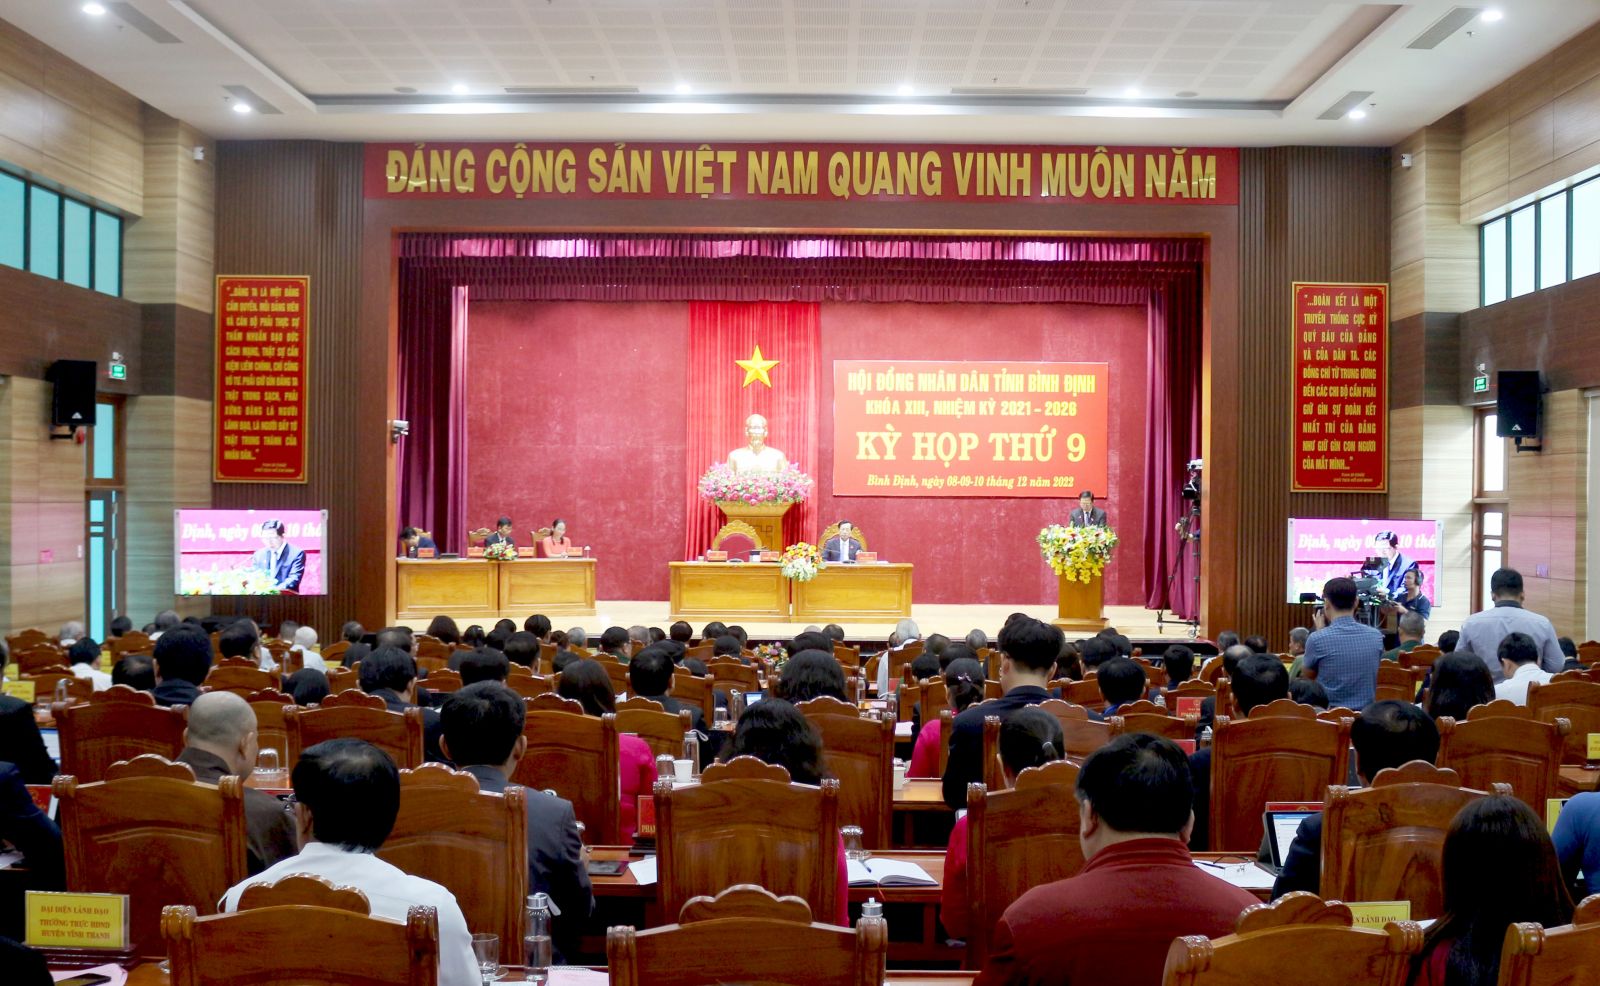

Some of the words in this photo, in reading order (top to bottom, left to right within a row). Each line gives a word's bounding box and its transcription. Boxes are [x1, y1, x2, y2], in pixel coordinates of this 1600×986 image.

[386, 142, 475, 193] ĐẢNG
[486, 143, 576, 199] CỘNG
[587, 142, 652, 193] SẢN
[661, 144, 737, 199] VIỆT
[747, 151, 818, 194] NAM
[828, 151, 942, 200] QUANG
[952, 152, 1031, 196] VINH
[1041, 145, 1135, 198] MUÔN
[1145, 147, 1216, 199] NĂM
[1335, 292, 1347, 307] KẾT
[1351, 293, 1359, 307] LÀ
[1363, 294, 1377, 310] MỘT
[1304, 309, 1326, 325] TRUYỀN
[1330, 310, 1349, 325] THỐNG
[1353, 313, 1365, 327] CỰC
[1369, 312, 1377, 325] KỲ
[1303, 329, 1316, 344] QUÝ
[1321, 329, 1335, 342] BÁU
[1340, 328, 1353, 342] CỦA
[1358, 328, 1376, 343] ĐẢNG
[1303, 347, 1311, 360] VÀ
[1316, 346, 1328, 360] CỦA
[1333, 348, 1346, 361] DÂN
[1364, 348, 1376, 361] CÁC
[1320, 366, 1330, 379] CHÍ
[848, 369, 872, 395] HỘI
[876, 366, 914, 392] ĐỒNG
[918, 370, 957, 392] NHÂN
[960, 370, 989, 392] DÂN
[993, 368, 1024, 392] TỈNH
[1028, 369, 1060, 393] BÌNH
[1064, 374, 1096, 397] ĐỊNH
[1316, 384, 1328, 397] CÁC
[865, 397, 900, 415] KHÓA
[933, 398, 976, 418] NHIỆM
[979, 397, 996, 415] KỲ
[1001, 401, 1031, 416] 2021
[1044, 401, 1077, 416] 2026
[1332, 404, 1341, 417] SỰ
[1365, 402, 1376, 416] KẾT
[1303, 419, 1320, 433] NHẤT
[1325, 420, 1335, 433] TRÍ
[1340, 419, 1353, 433] CỦA
[1358, 419, 1376, 434] ĐẢNG
[855, 423, 902, 461] KỲ
[912, 432, 979, 468] HỌP
[987, 424, 1057, 462] THỨ
[1066, 433, 1086, 463] 9
[1303, 455, 1314, 469] CỦA
[867, 475, 891, 486] Bình
[892, 475, 919, 488] Định,
[921, 477, 945, 489] ngày
[946, 476, 985, 487] 08-09-10
[986, 475, 1014, 489] tháng
[1017, 476, 1027, 487] 12
[1029, 478, 1051, 487] năm
[1053, 477, 1074, 487] 2022
